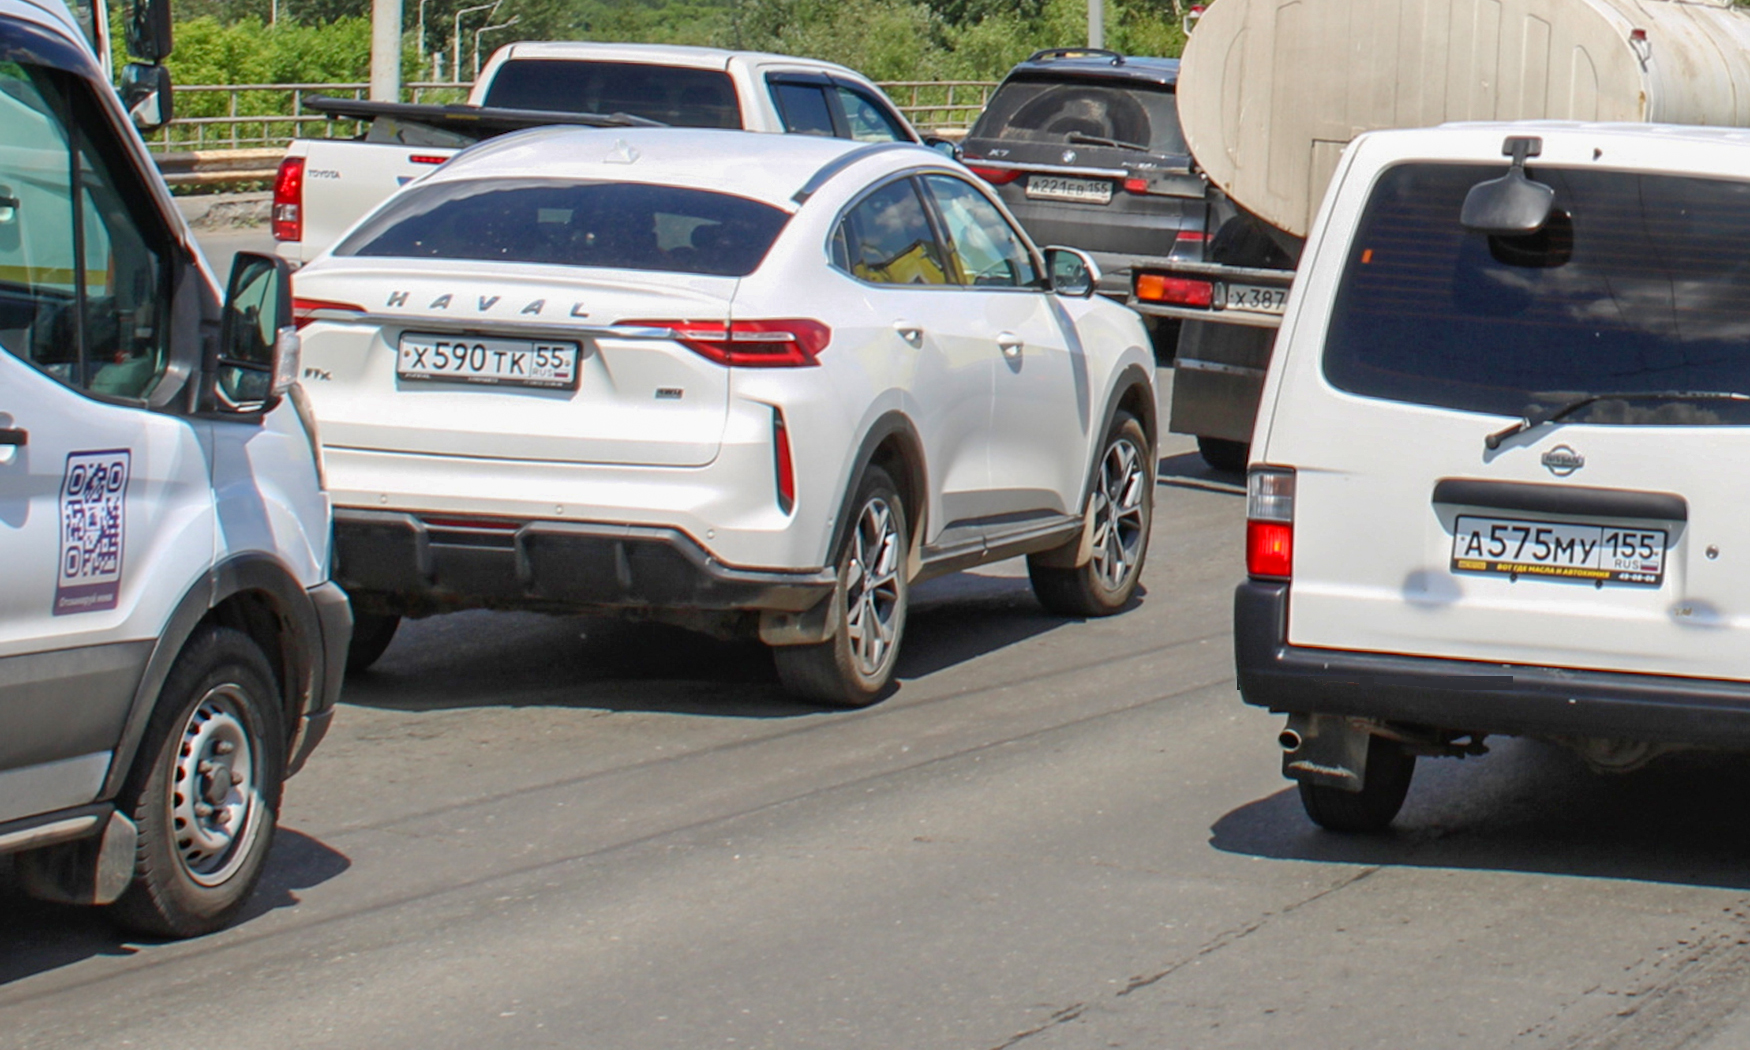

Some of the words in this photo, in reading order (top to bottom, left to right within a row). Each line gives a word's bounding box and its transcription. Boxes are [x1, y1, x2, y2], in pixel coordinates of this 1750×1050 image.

[308, 169, 341, 179] TOYOTA
[387, 291, 590, 318] HAVAL
[1497, 563, 1512, 571] ВОТ
[1513, 564, 1527, 573] ГДЕ
[1528, 565, 1554, 574] МАСЛА
[1614, 558, 1639, 570] RUS
